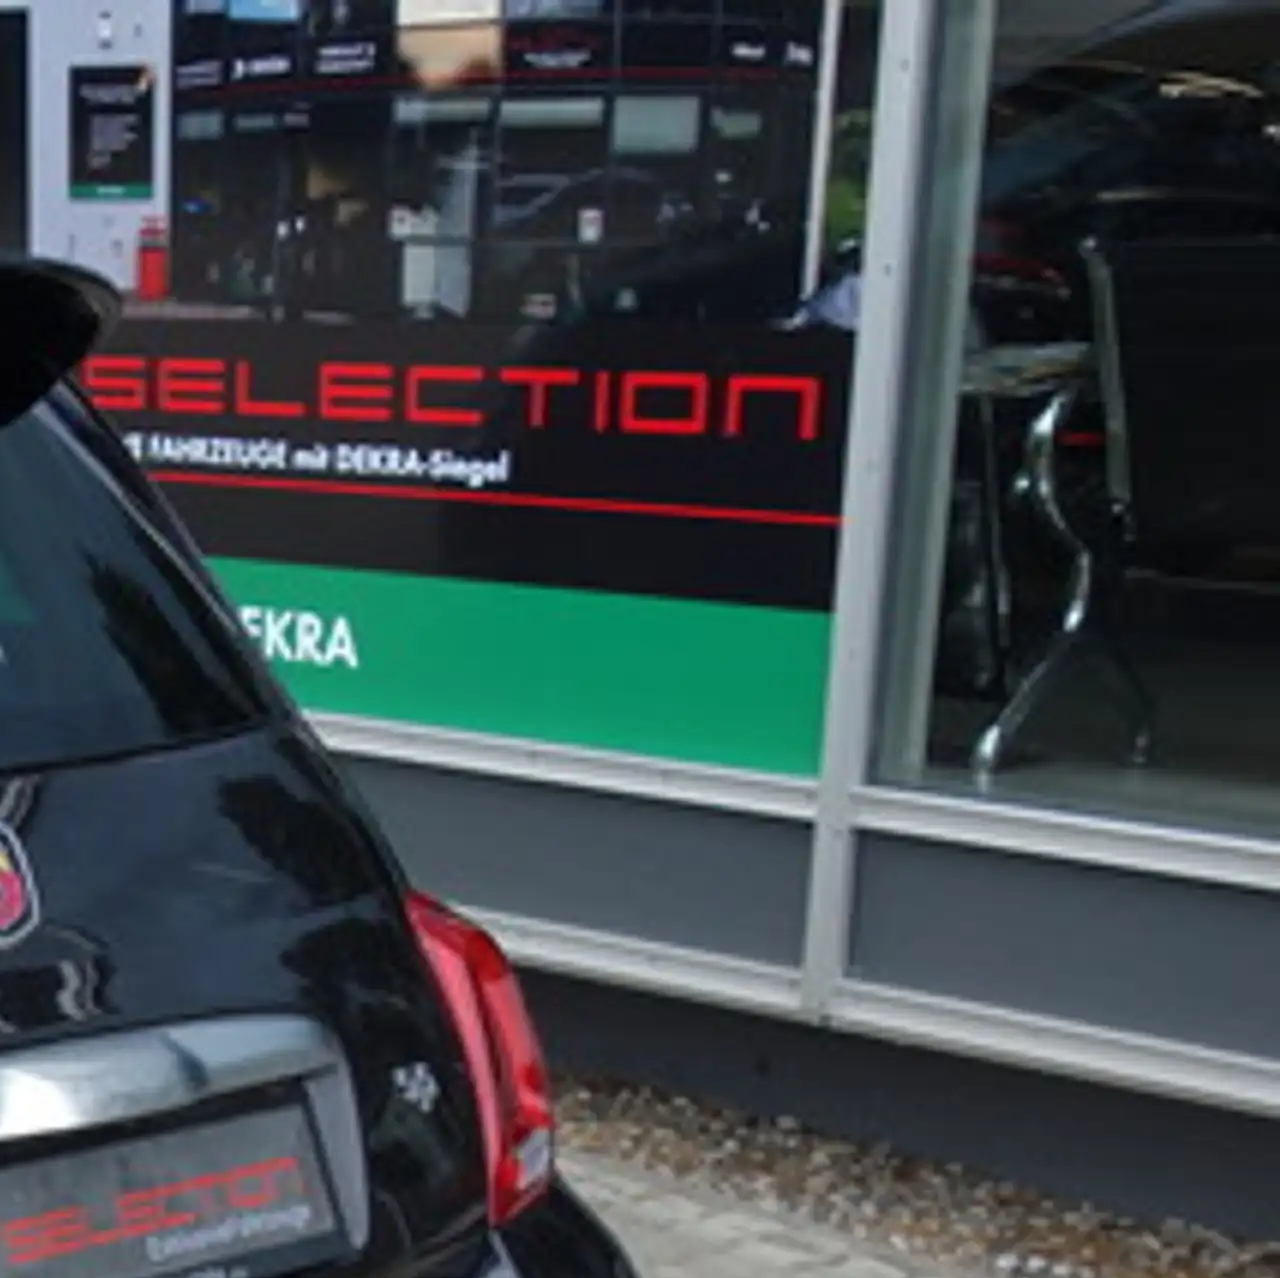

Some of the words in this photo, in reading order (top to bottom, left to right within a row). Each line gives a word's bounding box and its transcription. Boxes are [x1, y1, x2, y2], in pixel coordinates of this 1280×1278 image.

[83, 355, 821, 440] SELECTION
[151, 432, 287, 470] FAHRZEUGE
[294, 443, 329, 471] mit
[336, 443, 510, 488] DEKRA-Siegel
